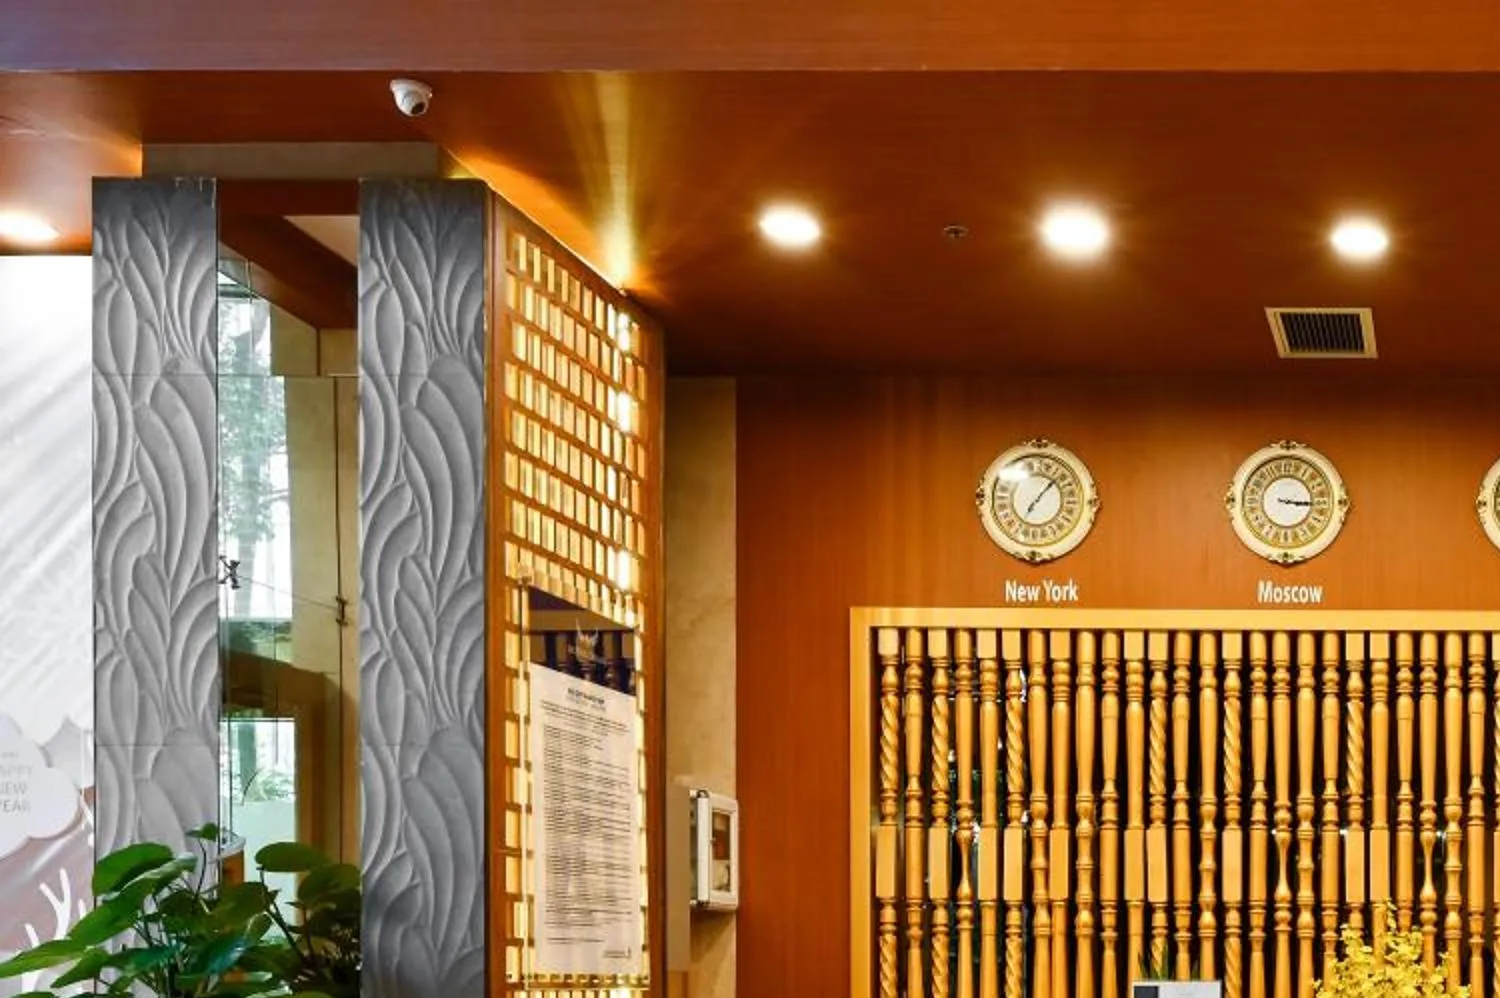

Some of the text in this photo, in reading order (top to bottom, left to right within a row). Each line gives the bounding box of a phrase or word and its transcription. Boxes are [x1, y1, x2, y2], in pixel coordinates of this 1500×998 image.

[1004, 579, 1079, 603] New York
[1257, 580, 1324, 604] Moscow
